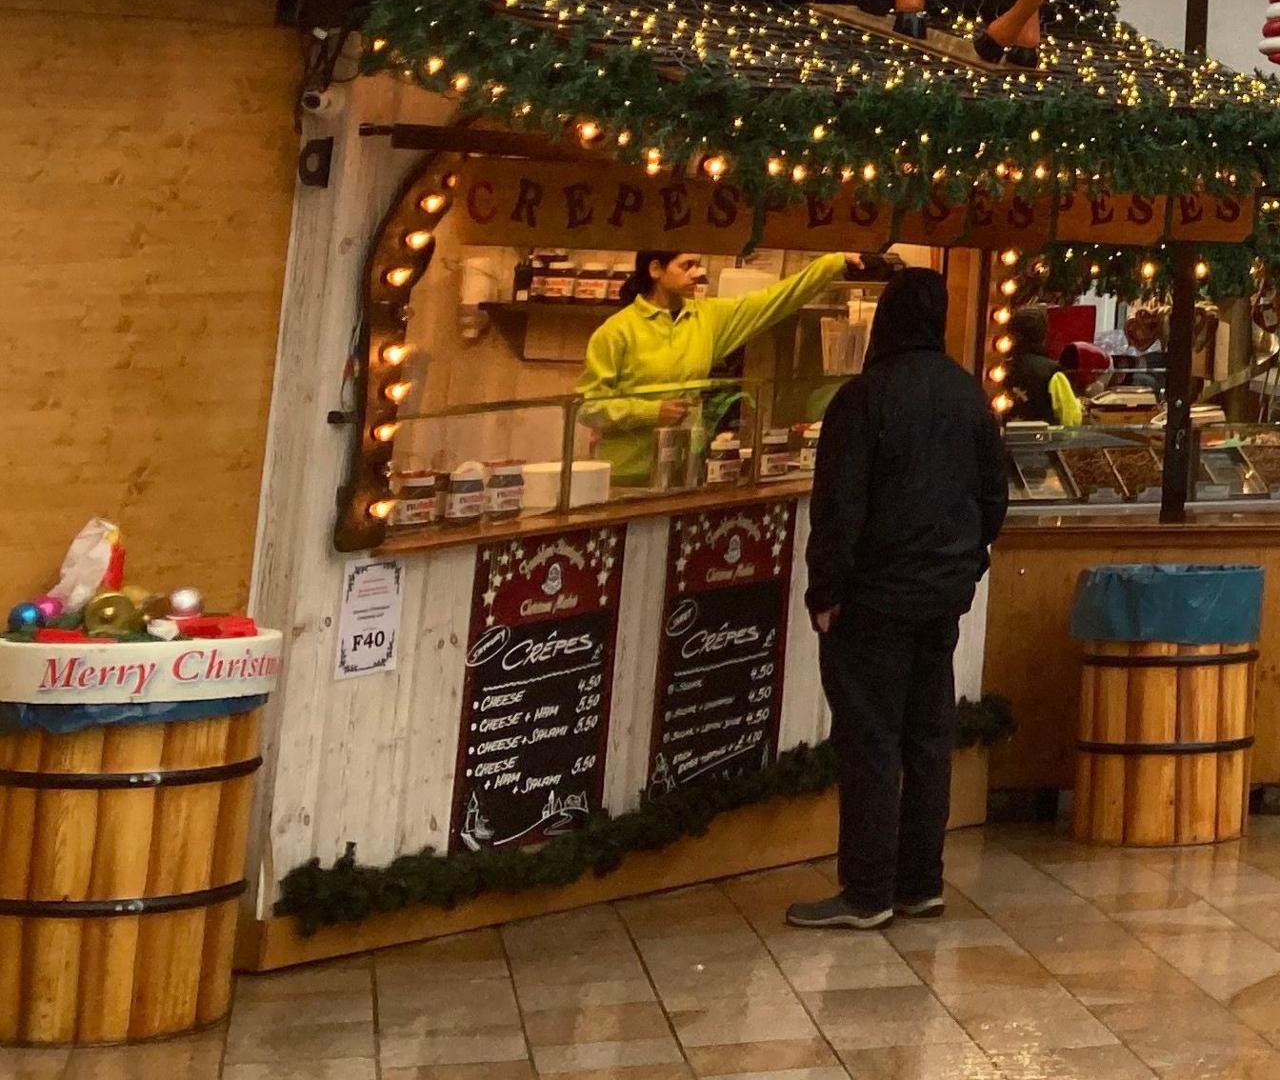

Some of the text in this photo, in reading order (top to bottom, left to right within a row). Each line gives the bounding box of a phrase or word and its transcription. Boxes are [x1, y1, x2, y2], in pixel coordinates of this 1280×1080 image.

[466, 177, 740, 232] CREPES
[352, 631, 385, 651] F40
[502, 631, 593, 670] CRÊPES
[681, 622, 760, 659] CRÊPES
[38, 657, 157, 695] Merry
[480, 690, 526, 712] CHEESE
[479, 711, 523, 733] CHEESE
[474, 756, 520, 778] CHEESE
